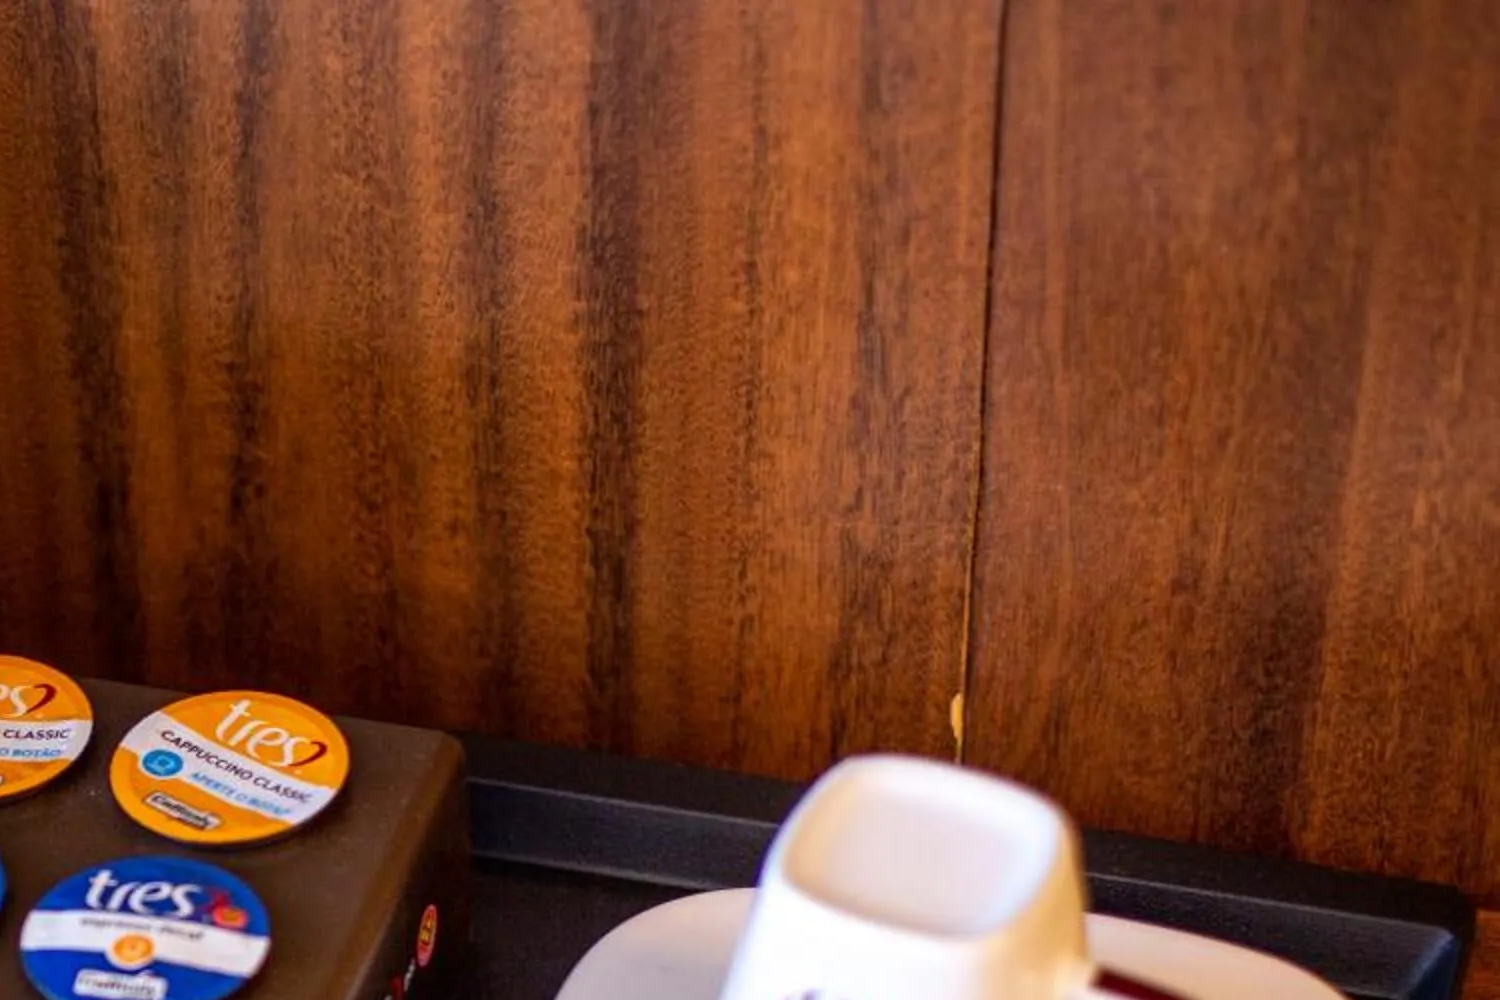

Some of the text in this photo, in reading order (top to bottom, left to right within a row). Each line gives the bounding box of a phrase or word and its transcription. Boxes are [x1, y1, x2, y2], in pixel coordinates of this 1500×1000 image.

[3, 728, 72, 742] CLASSIC
[216, 699, 312, 767] tres
[160, 729, 313, 804] CAPPUCCINO CLASSIC
[85, 868, 203, 918] tres
